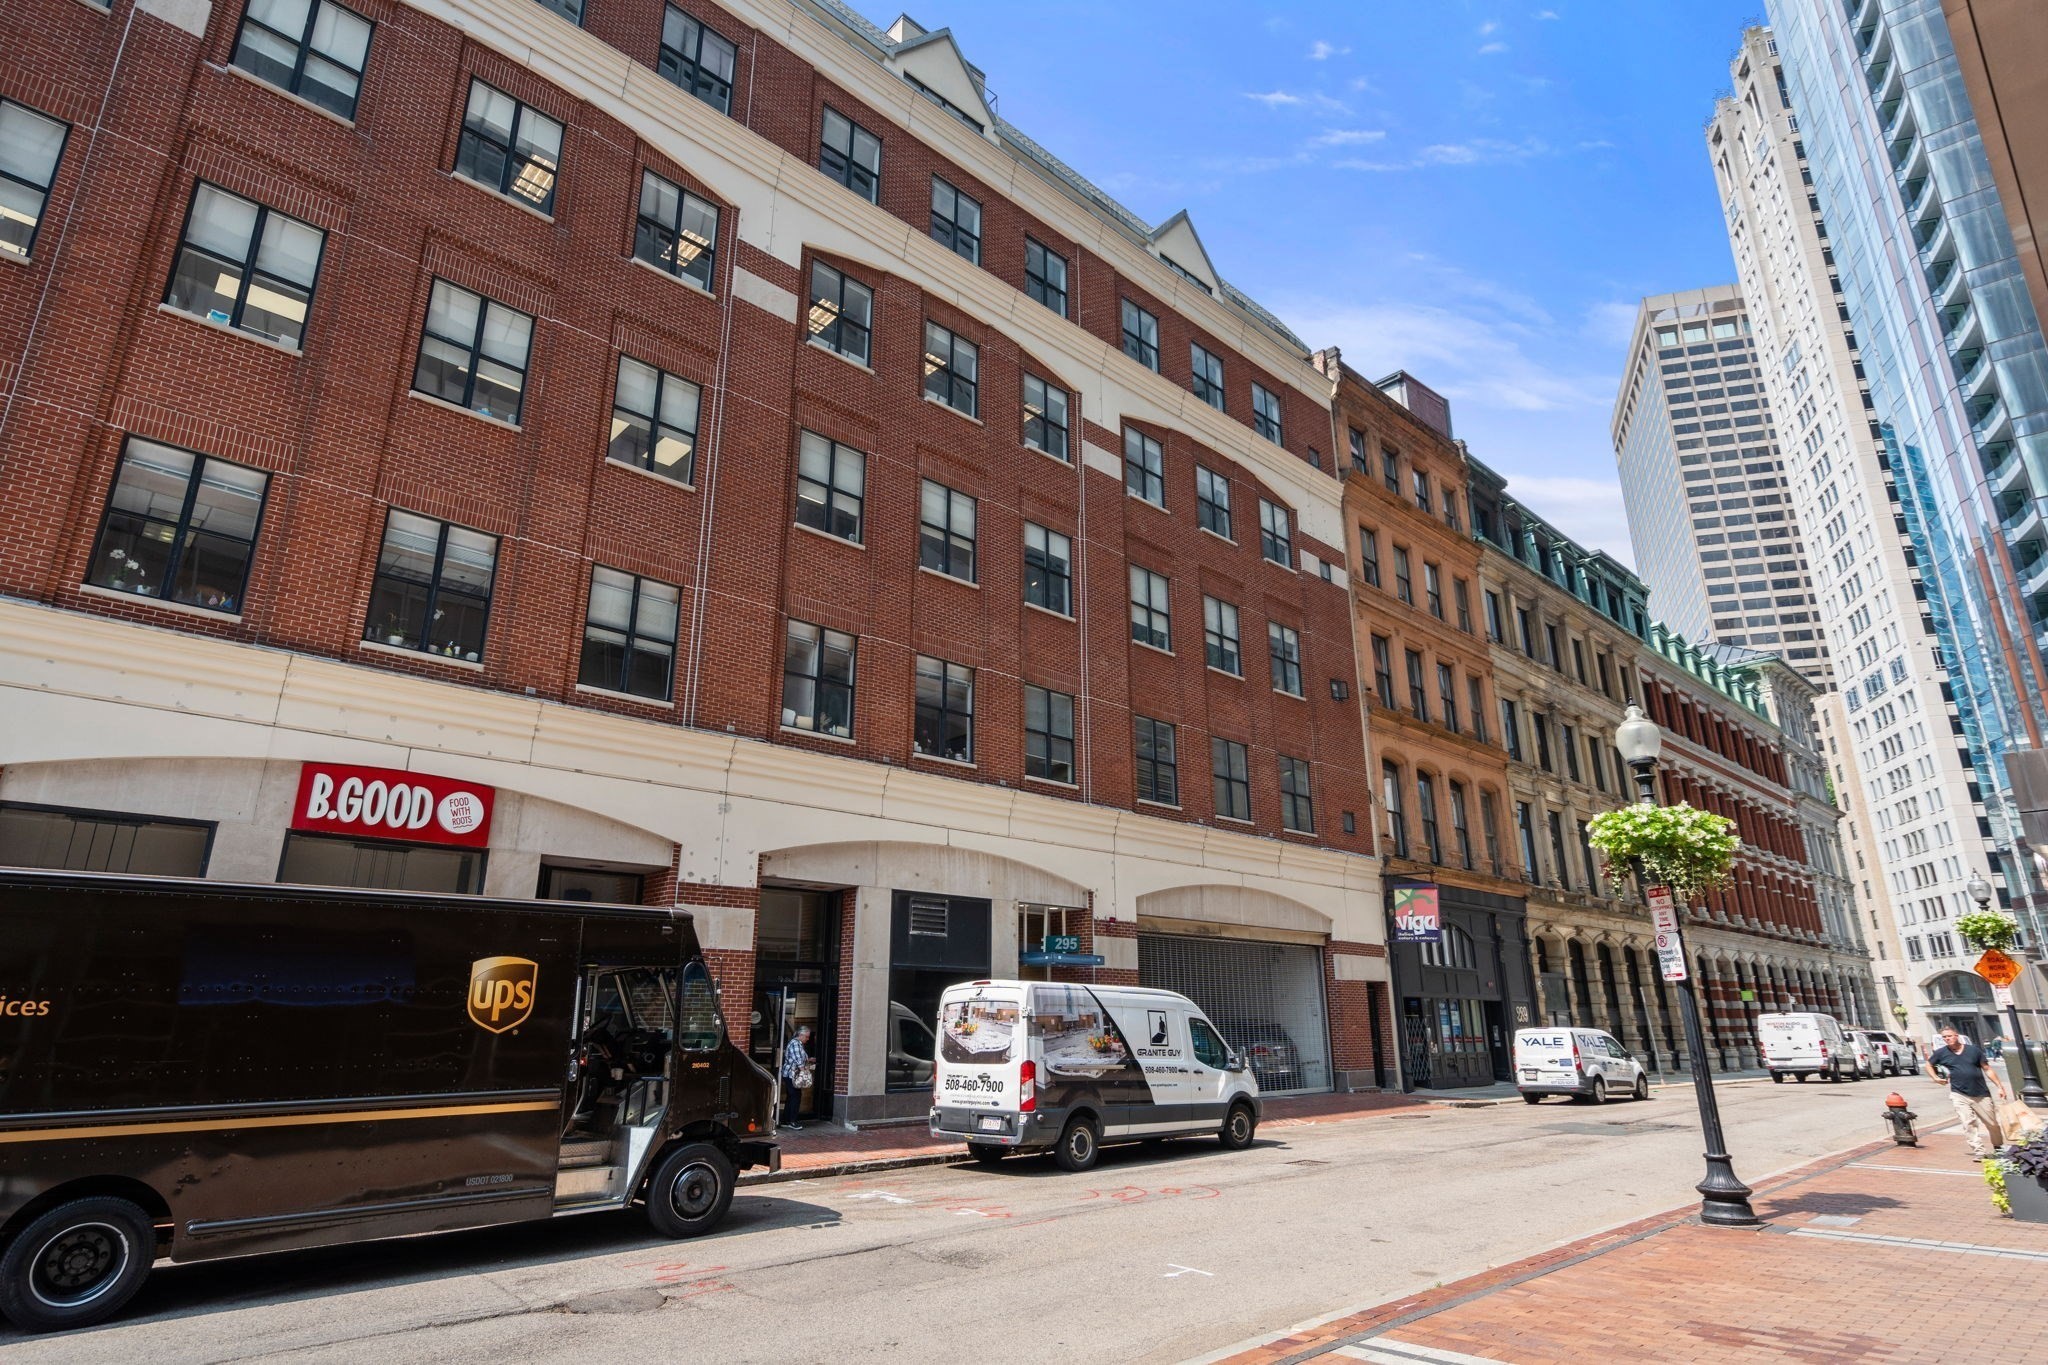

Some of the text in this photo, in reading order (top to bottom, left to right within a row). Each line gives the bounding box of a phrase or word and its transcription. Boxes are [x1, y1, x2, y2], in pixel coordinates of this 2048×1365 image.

[306, 772, 434, 829] B.GOOD
[449, 797, 470, 807] FOOD
[450, 806, 471, 817] WITH
[452, 815, 473, 826] ROOTS
[1395, 910, 1439, 935] viga
[1055, 937, 1078, 950] 295
[473, 979, 532, 1021] ups
[1521, 1038, 1564, 1046] YALE
[1578, 1035, 1606, 1048] YALE
[1137, 1048, 1182, 1057] GRANITE GUY
[1145, 1066, 1178, 1074] 508-460-7900
[945, 1078, 1004, 1093] 508-460-7900
[466, 1176, 489, 1186] USDOT
